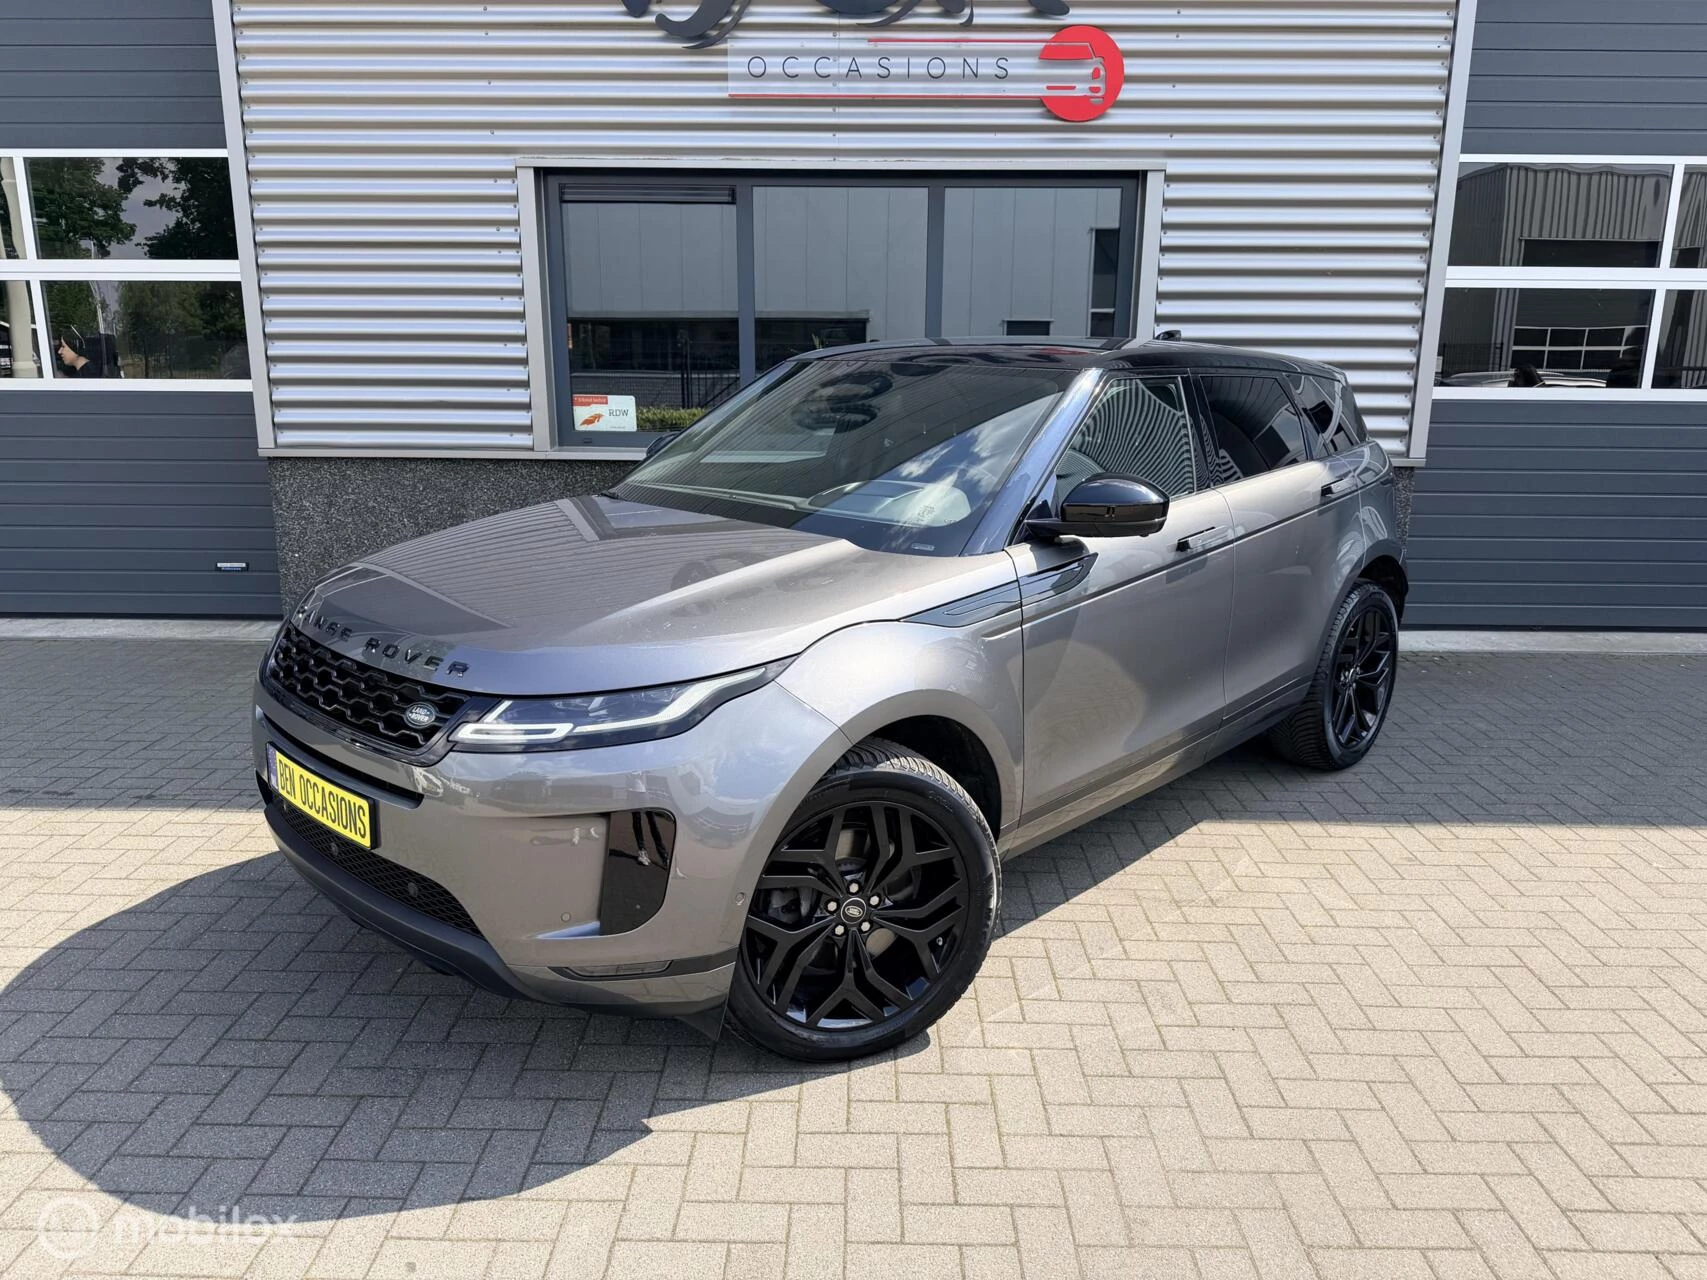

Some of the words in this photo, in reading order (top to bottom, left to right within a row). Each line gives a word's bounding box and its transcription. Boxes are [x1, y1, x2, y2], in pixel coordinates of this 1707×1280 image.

[746, 55, 1010, 80] OCCASIONS
[608, 408, 629, 417] RDW
[365, 636, 469, 677] ROVER
[278, 758, 297, 800] BEN
[299, 773, 367, 840] OCCASIONS
